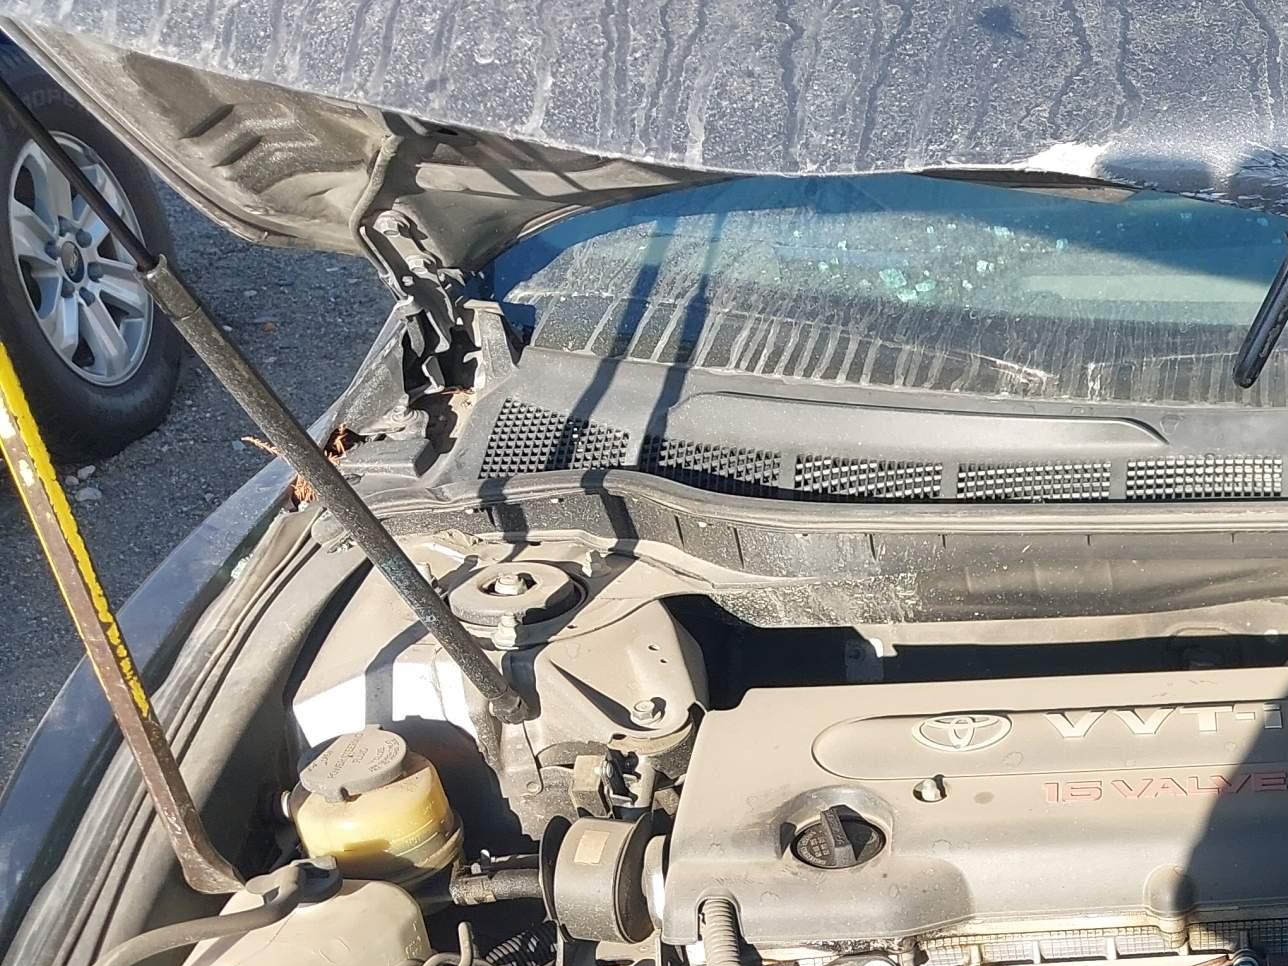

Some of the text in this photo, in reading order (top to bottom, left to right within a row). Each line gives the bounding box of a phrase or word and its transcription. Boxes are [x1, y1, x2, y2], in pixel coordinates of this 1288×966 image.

[1043, 702, 1283, 739] VVT-i
[1044, 771, 1288, 802] 16 VALVE
